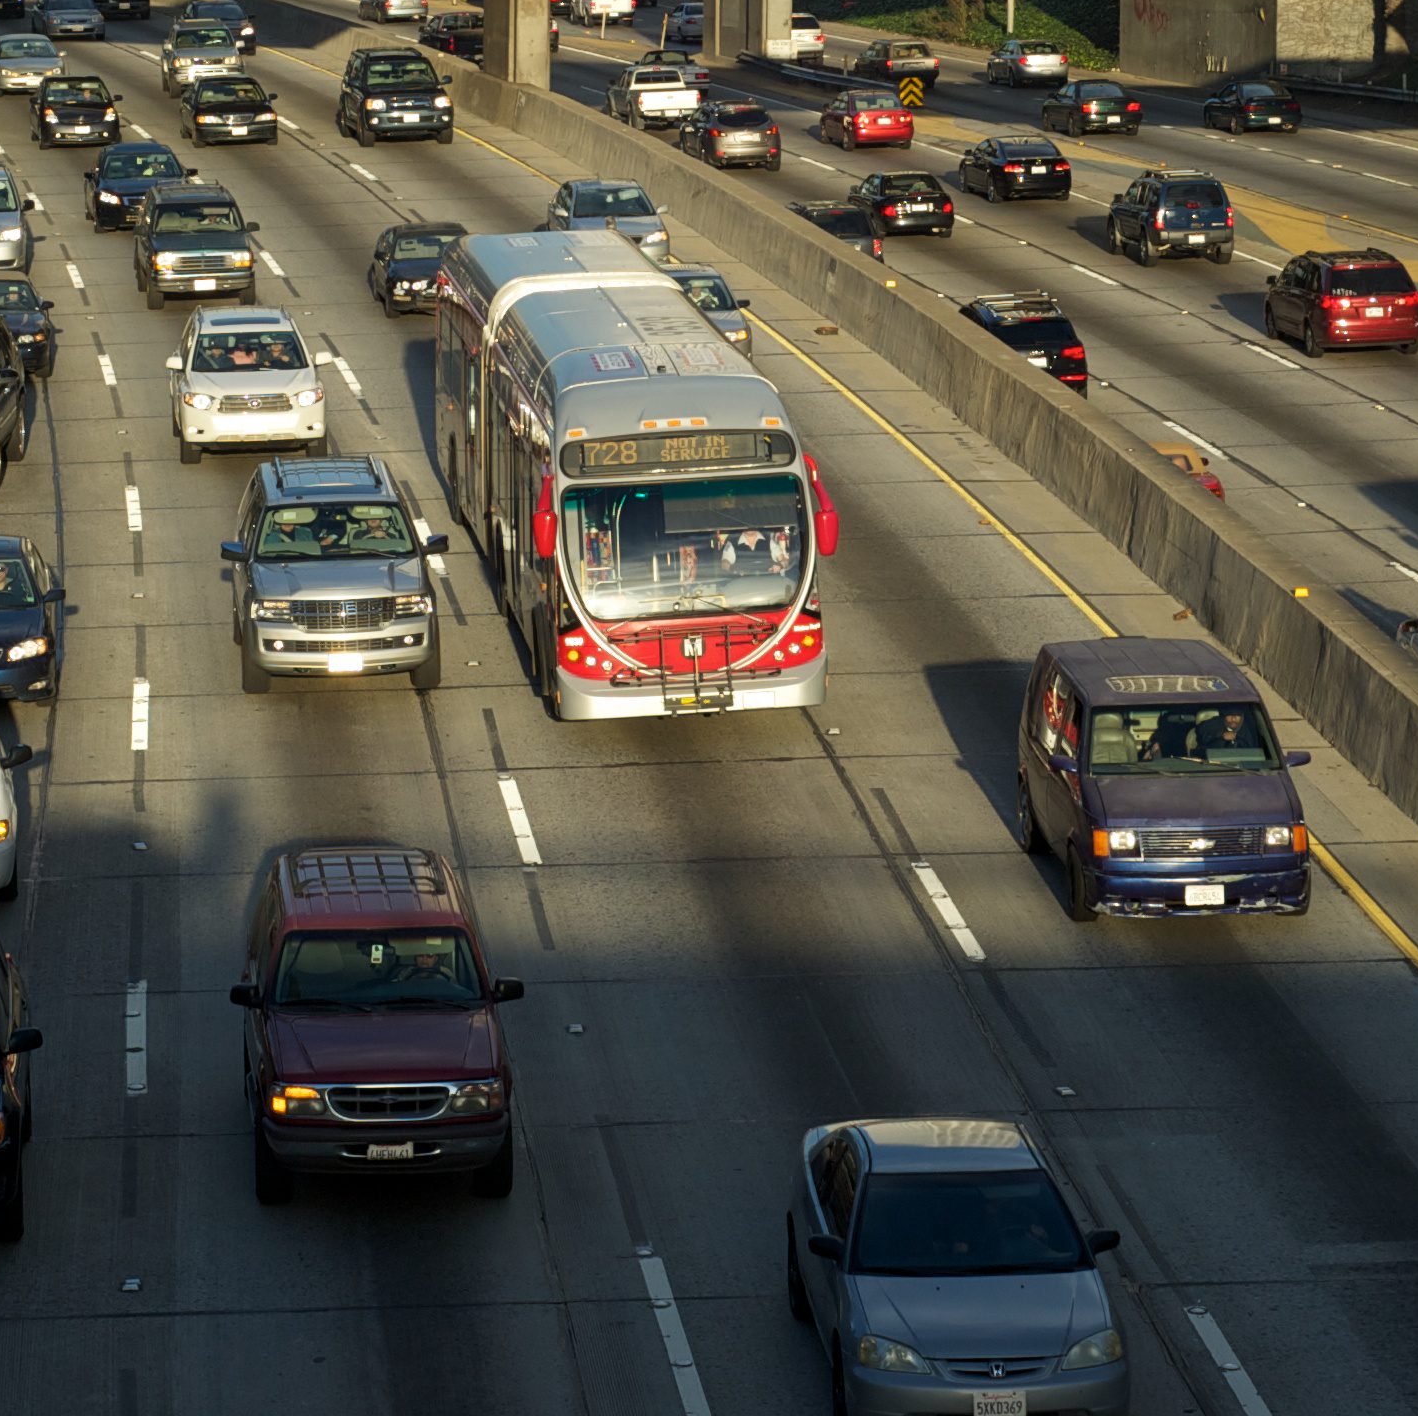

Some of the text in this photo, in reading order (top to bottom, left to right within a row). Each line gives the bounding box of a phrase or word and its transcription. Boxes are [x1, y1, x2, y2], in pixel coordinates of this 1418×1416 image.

[583, 436, 725, 466] 728 NOT IN
[661, 446, 730, 462] SERVICE
[976, 1401, 1023, 1416] 5XKD369
